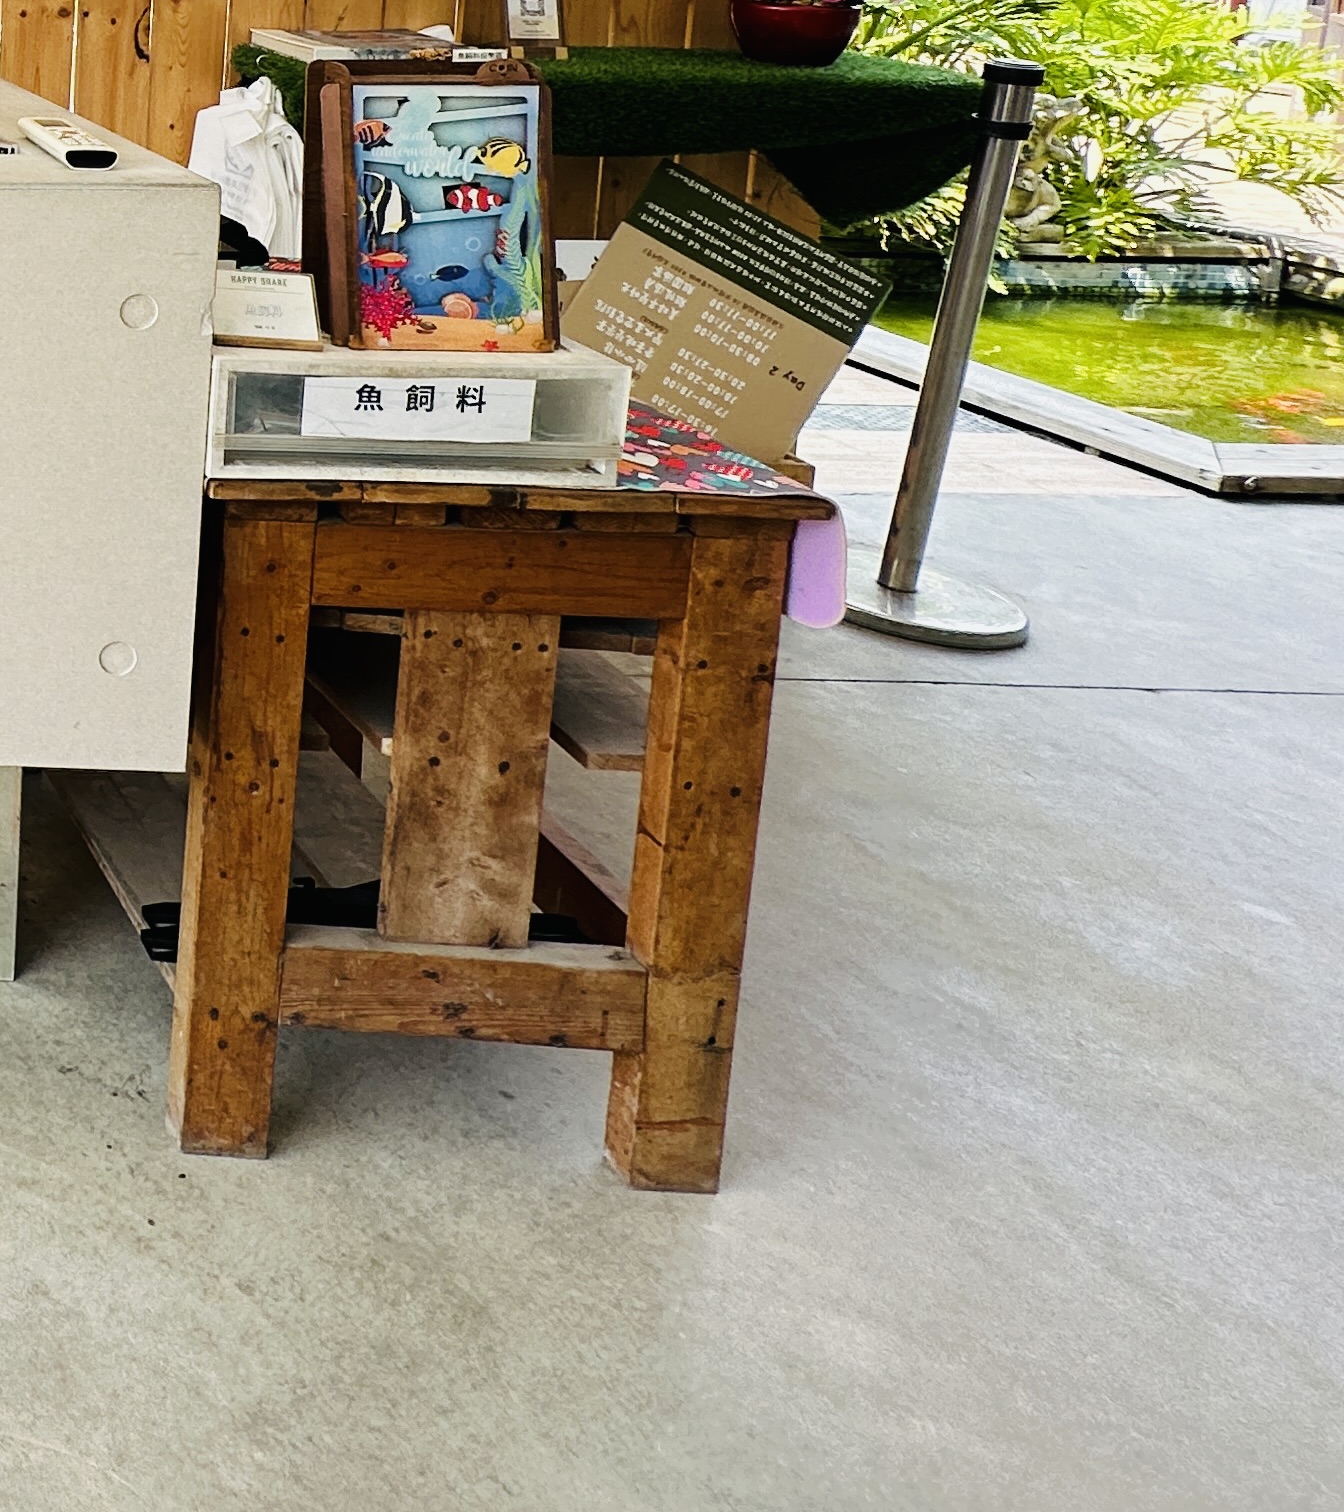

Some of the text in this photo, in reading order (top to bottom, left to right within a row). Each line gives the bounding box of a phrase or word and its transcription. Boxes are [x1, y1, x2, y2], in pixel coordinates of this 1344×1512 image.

[404, 144, 479, 183] world
[230, 275, 257, 284] HAPPY
[768, 365, 779, 376] 2
[782, 370, 806, 391] Day
[353, 383, 487, 414] 魚飼料
